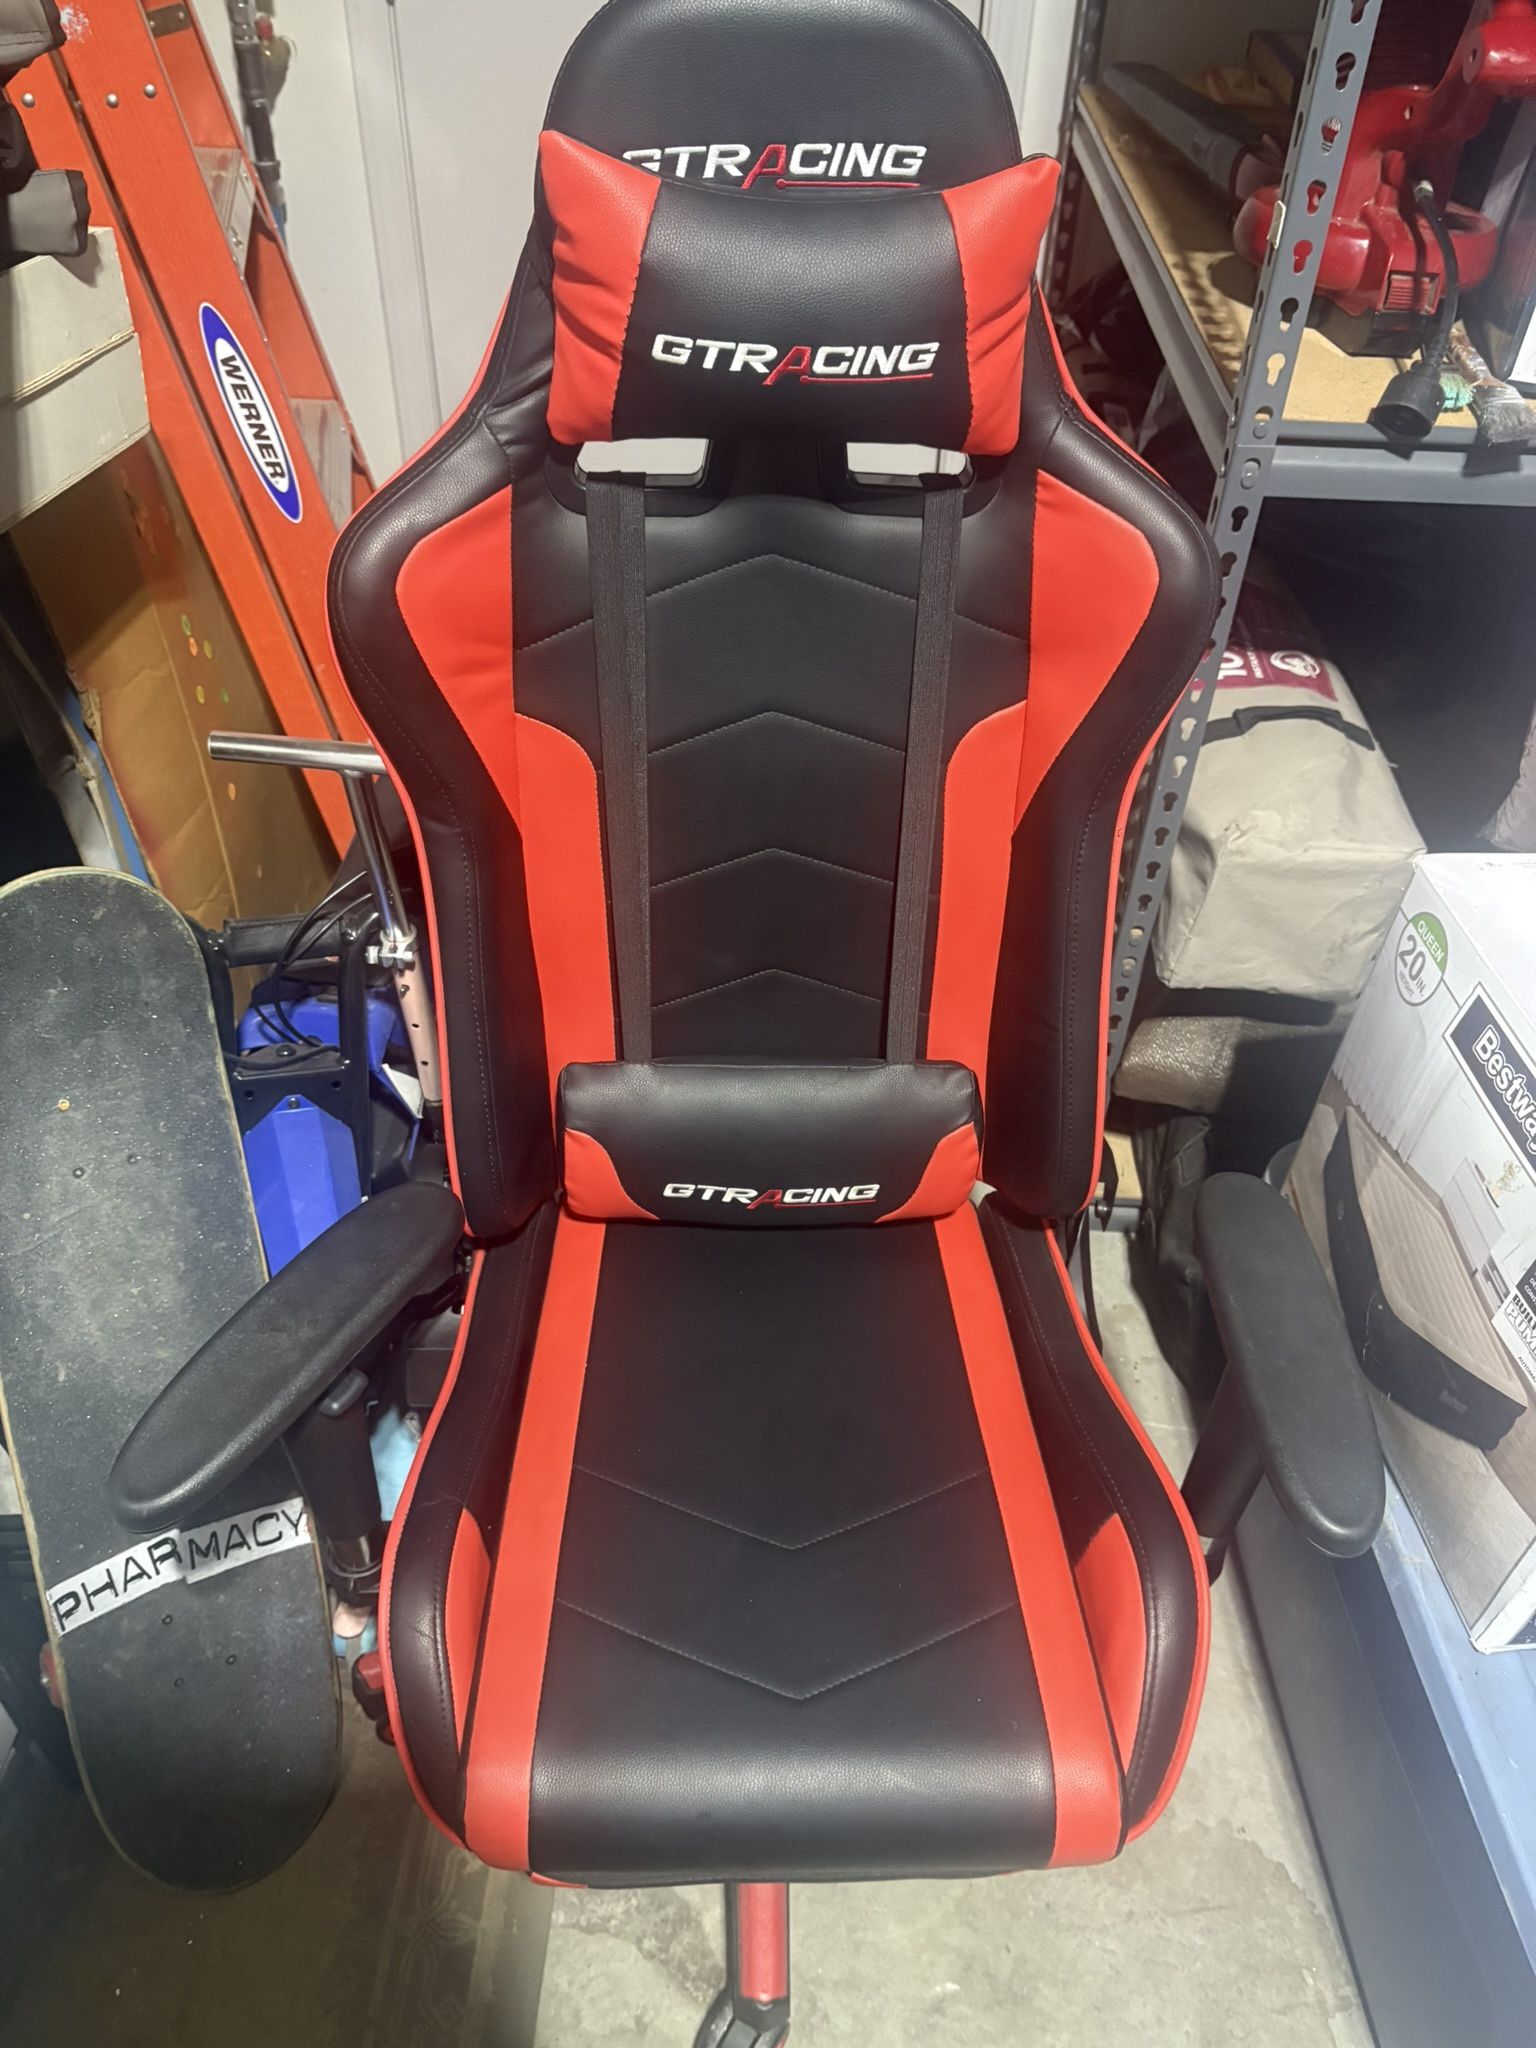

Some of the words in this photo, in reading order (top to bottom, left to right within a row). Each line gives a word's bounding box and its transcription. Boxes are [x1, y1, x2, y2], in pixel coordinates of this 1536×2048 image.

[651, 333, 940, 386] GTRACING
[219, 353, 286, 480] WERNER
[1398, 934, 1426, 982] 20
[1417, 920, 1445, 963] QUEEN
[662, 1183, 880, 1210] GTRACING
[51, 1506, 304, 1633] PHARMACY
